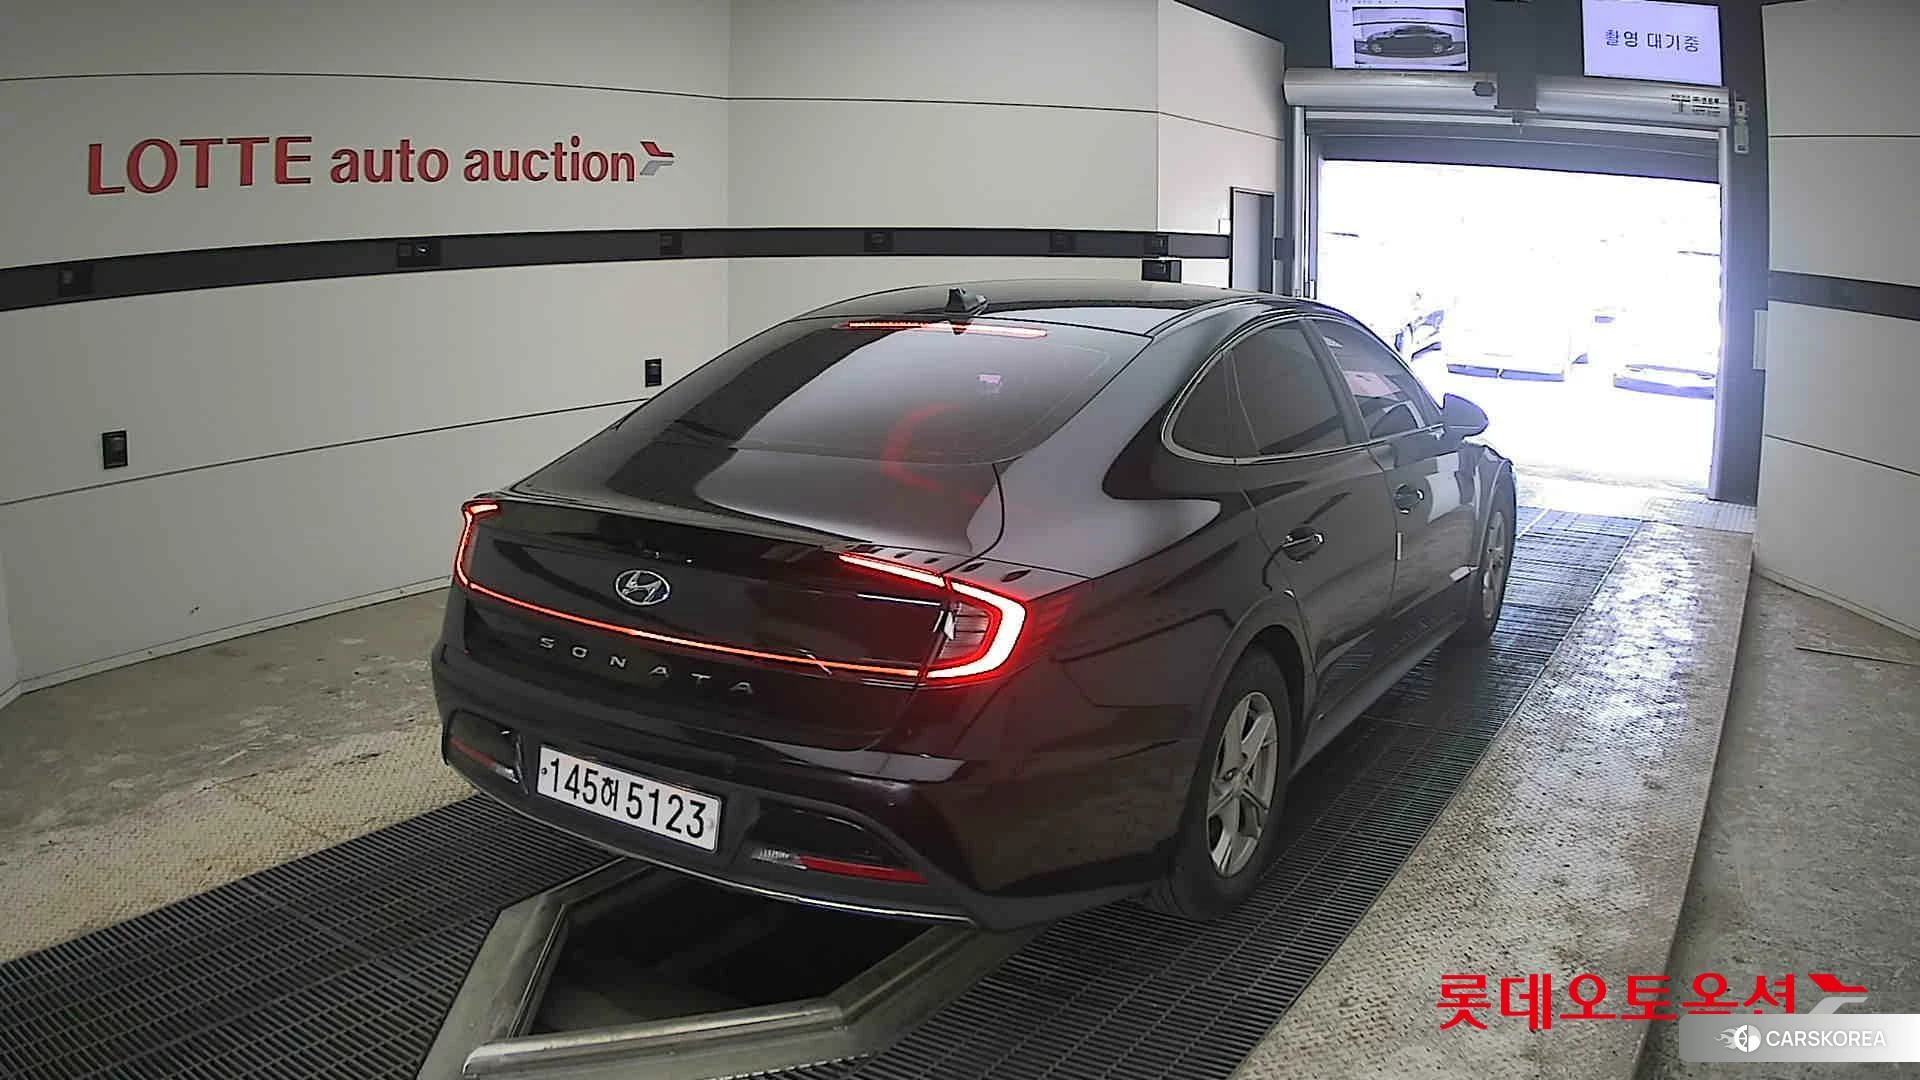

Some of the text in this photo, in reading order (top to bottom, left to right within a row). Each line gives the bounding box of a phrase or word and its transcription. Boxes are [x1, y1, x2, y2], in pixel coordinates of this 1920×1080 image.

[1646, 32, 1699, 52] 대기중
[87, 135, 635, 195] LOTTE auto auction
[538, 636, 754, 695] SONATA
[549, 757, 707, 839] 145허 5123
